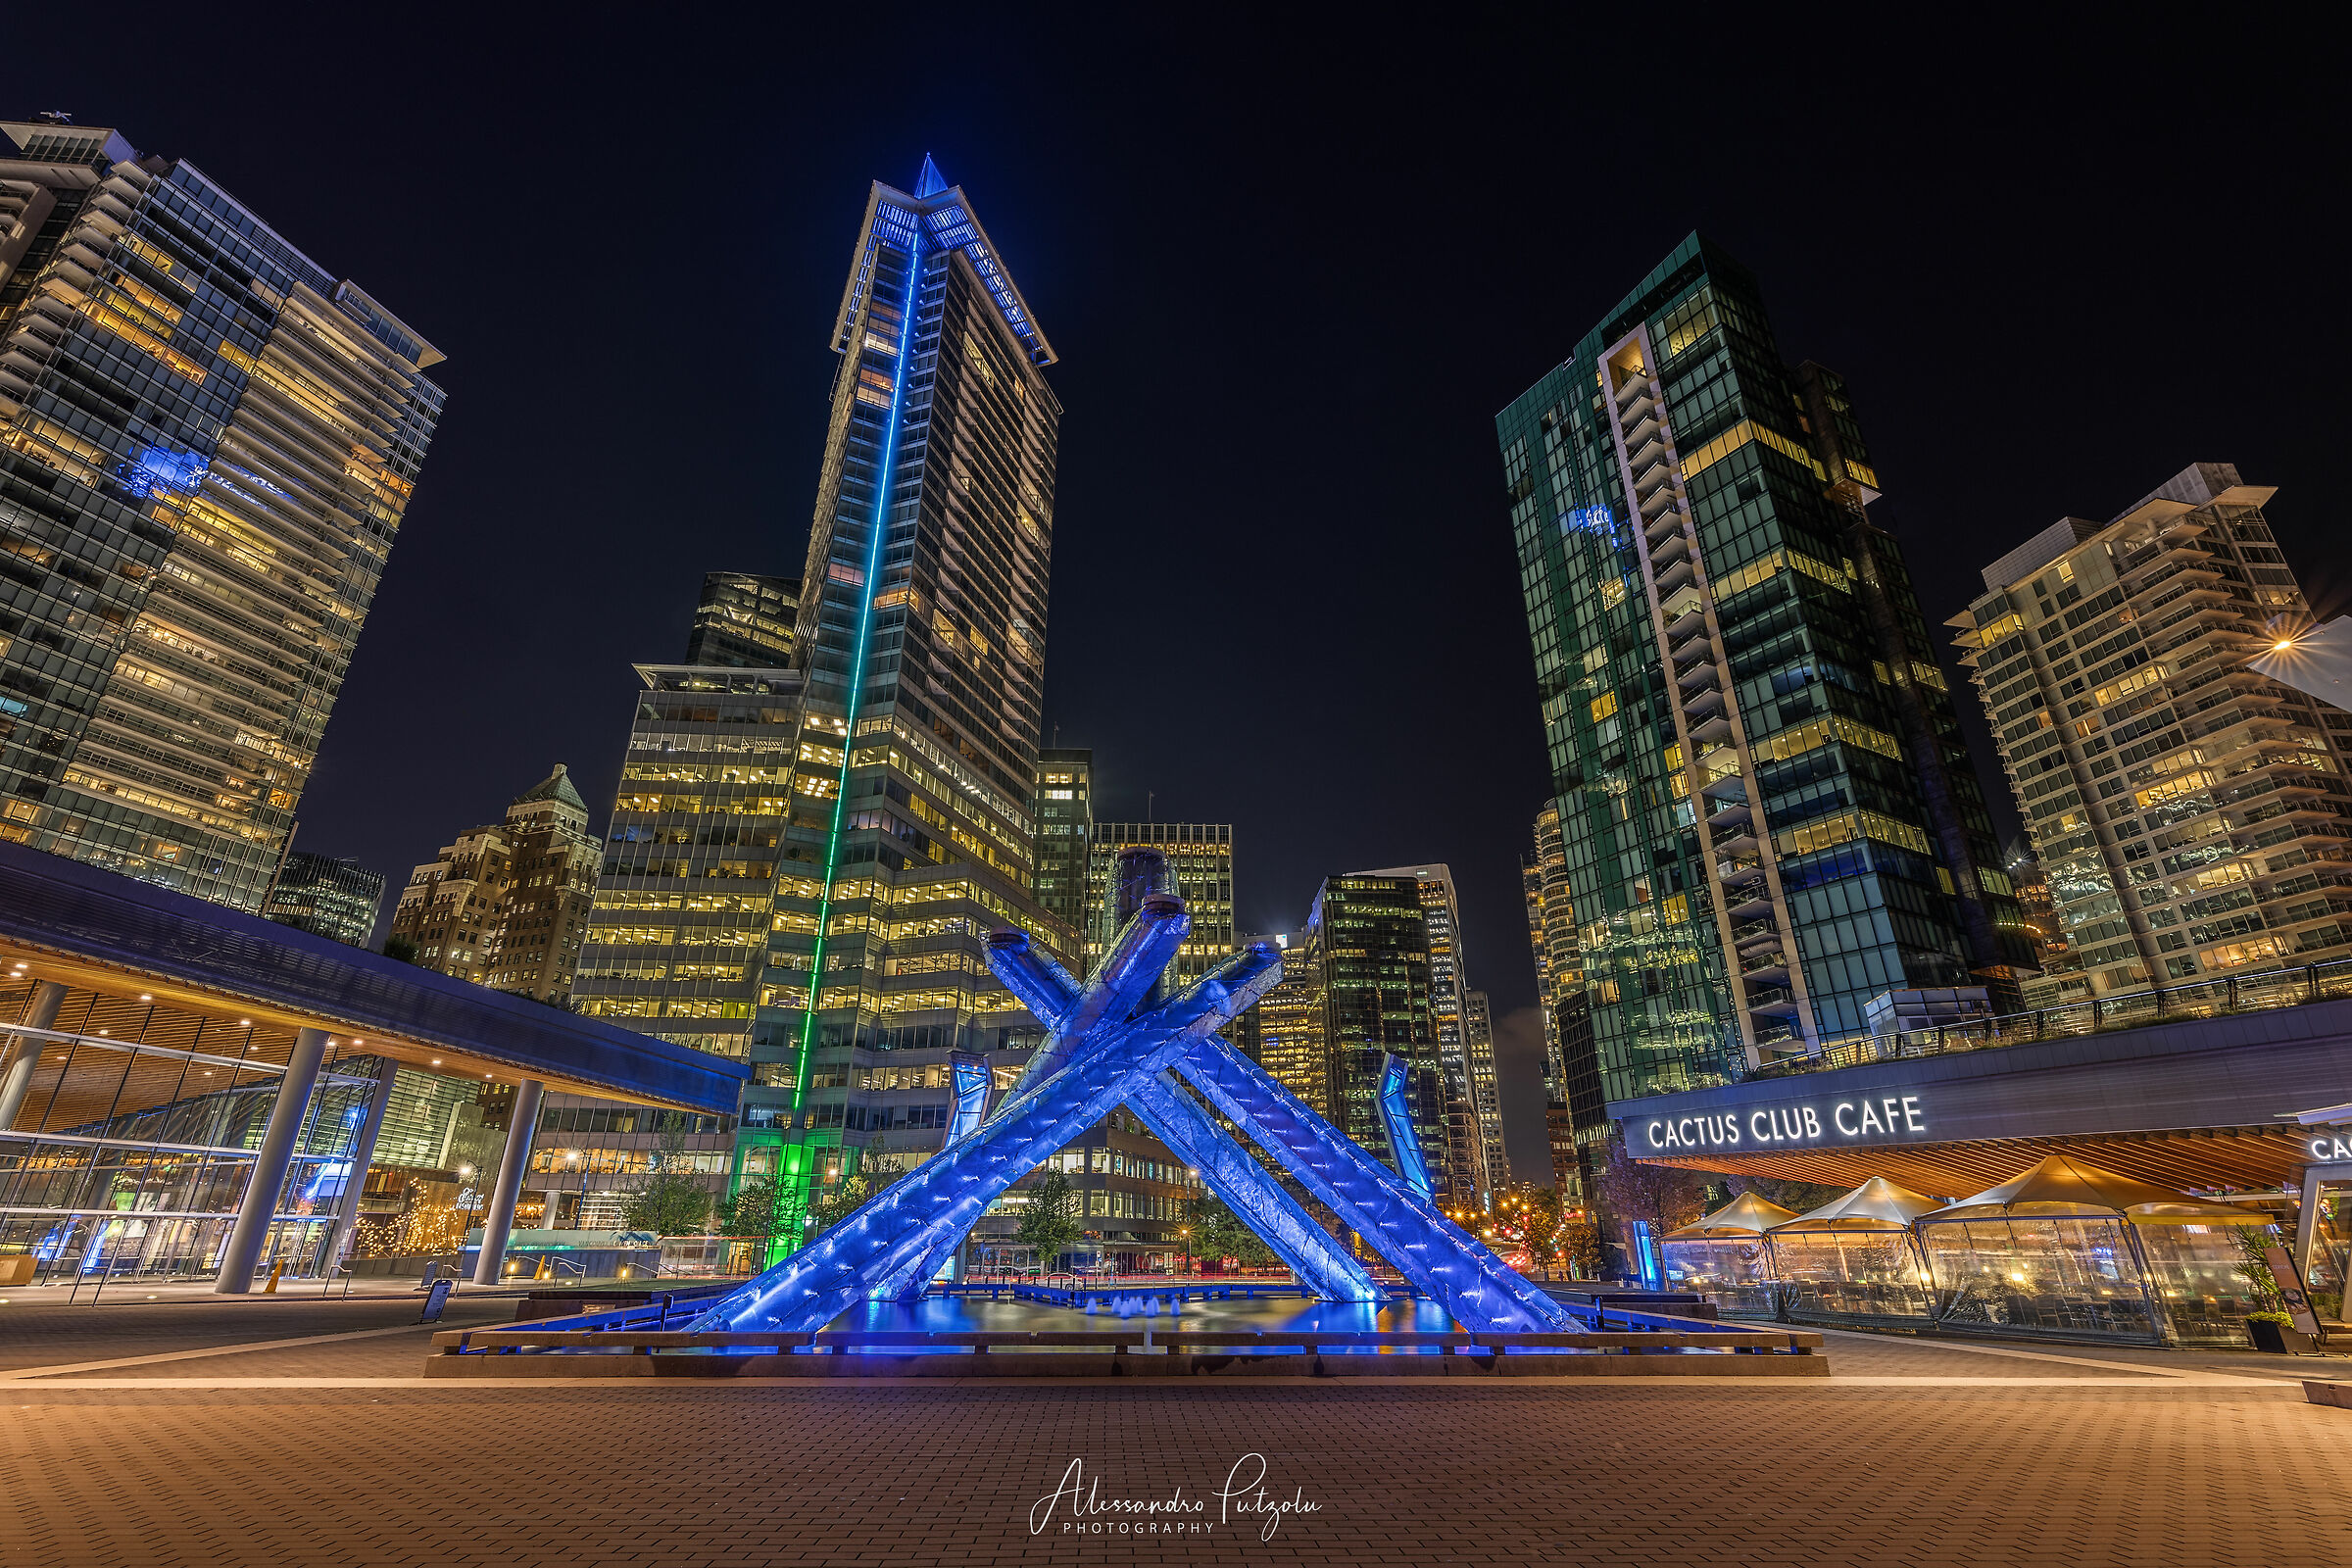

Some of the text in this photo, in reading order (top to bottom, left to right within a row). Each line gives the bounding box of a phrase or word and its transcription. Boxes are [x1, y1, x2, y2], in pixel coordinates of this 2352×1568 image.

[1648, 1096, 1926, 1149] CACTUS CLUB CAFE
[2311, 1138, 2352, 1159] CA
